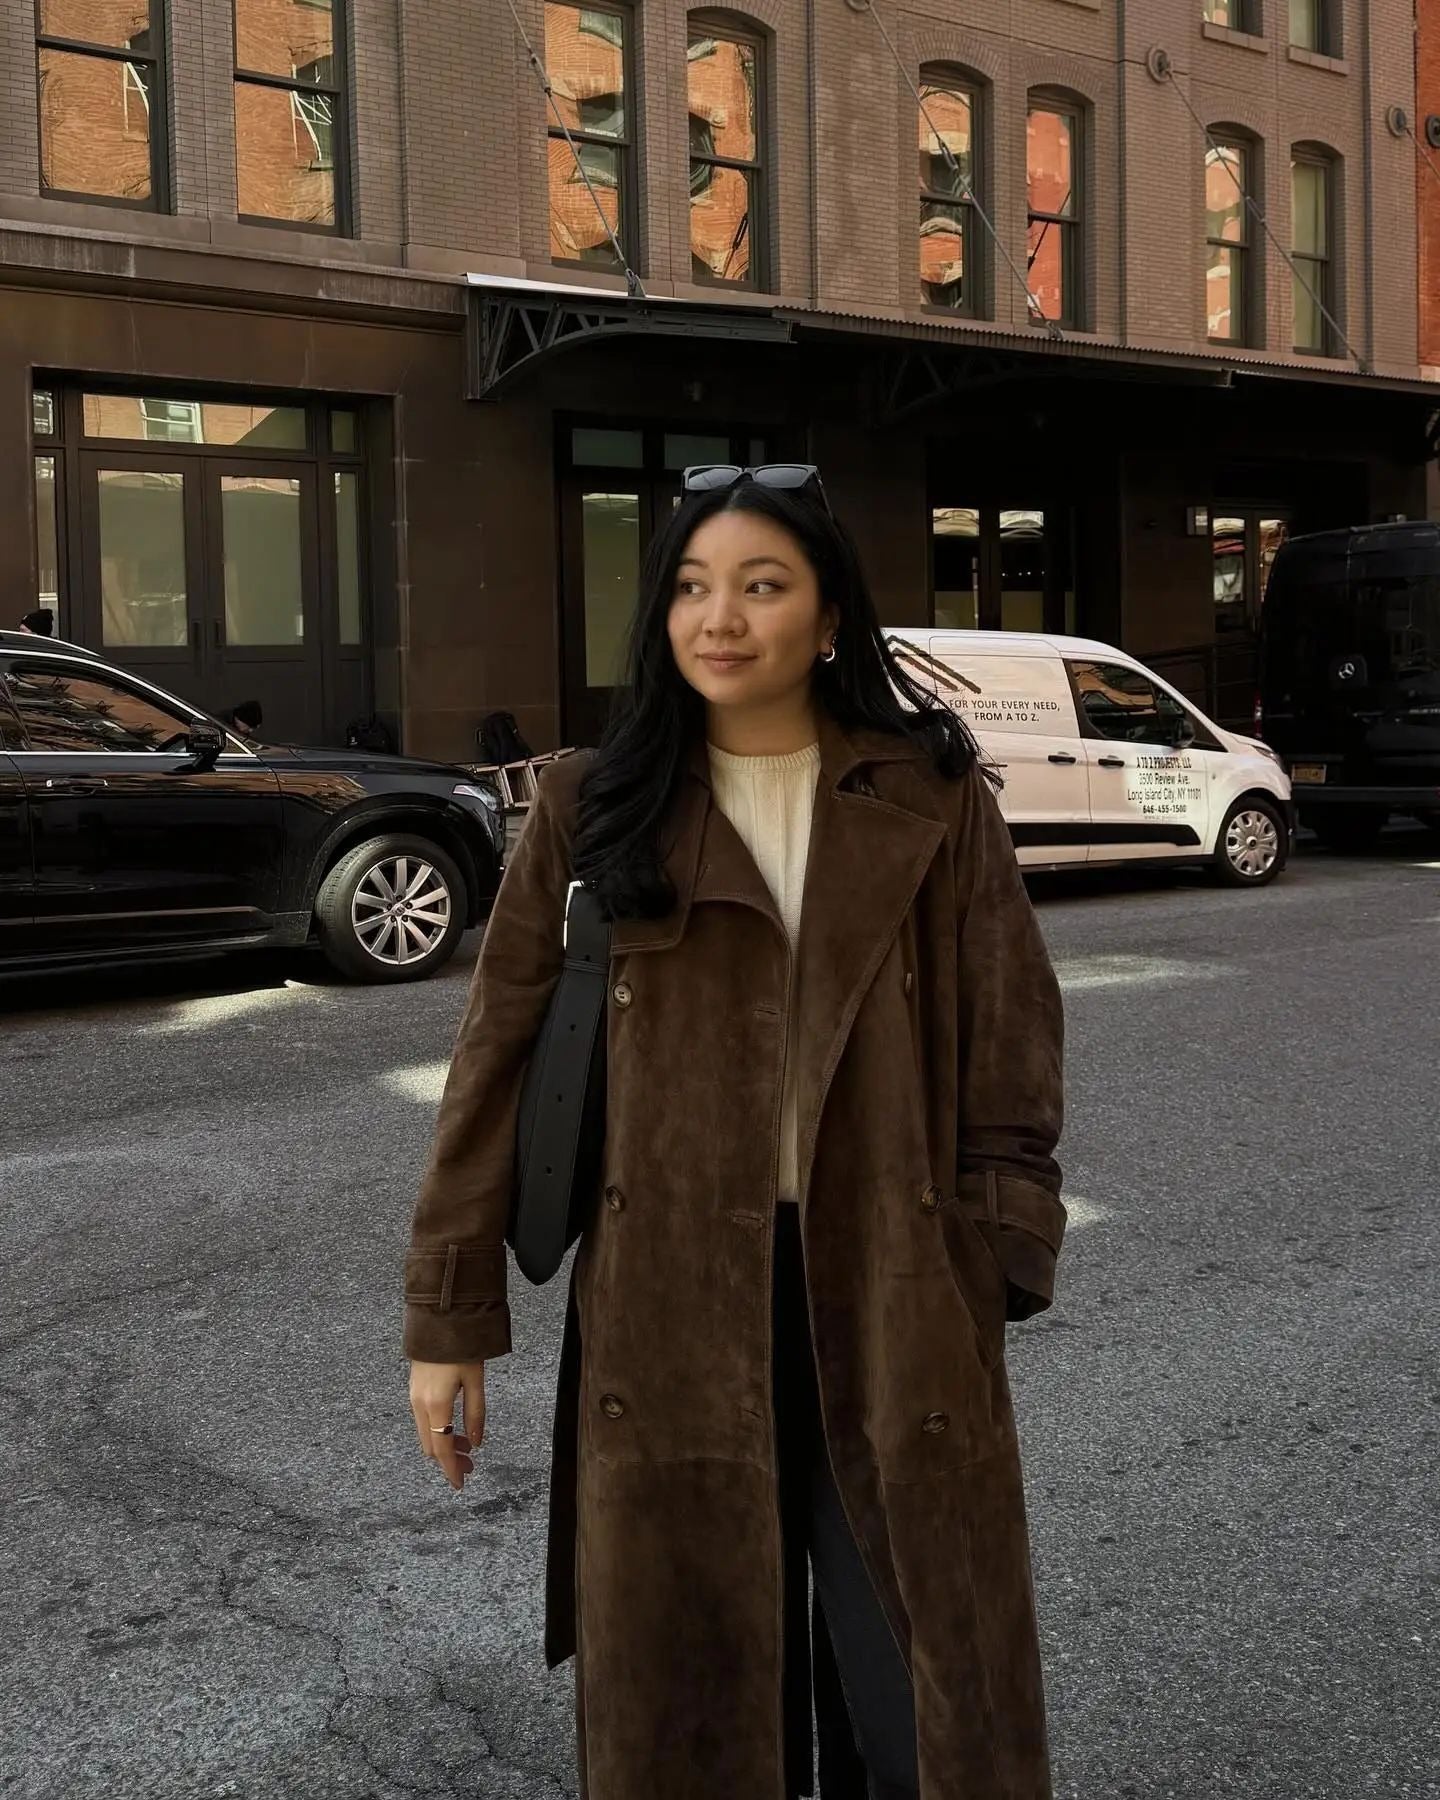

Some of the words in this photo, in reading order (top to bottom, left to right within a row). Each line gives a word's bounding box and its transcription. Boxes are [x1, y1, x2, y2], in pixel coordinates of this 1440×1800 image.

[971, 700, 998, 709] YOUR
[1001, 701, 1030, 710] EVERY
[1034, 702, 1060, 711] NEED,
[974, 712, 1003, 721] FROM
[1006, 713, 1013, 721] A
[1015, 713, 1028, 721] TO
[1031, 714, 1040, 722] Z.
[1136, 756, 1141, 769] A
[1141, 756, 1148, 769] TO
[1154, 772, 1176, 785] Review
[1176, 772, 1191, 785] Ave.
[1127, 788, 1143, 804] Long
[1144, 787, 1162, 801] Island
[1177, 787, 1186, 800] NY
